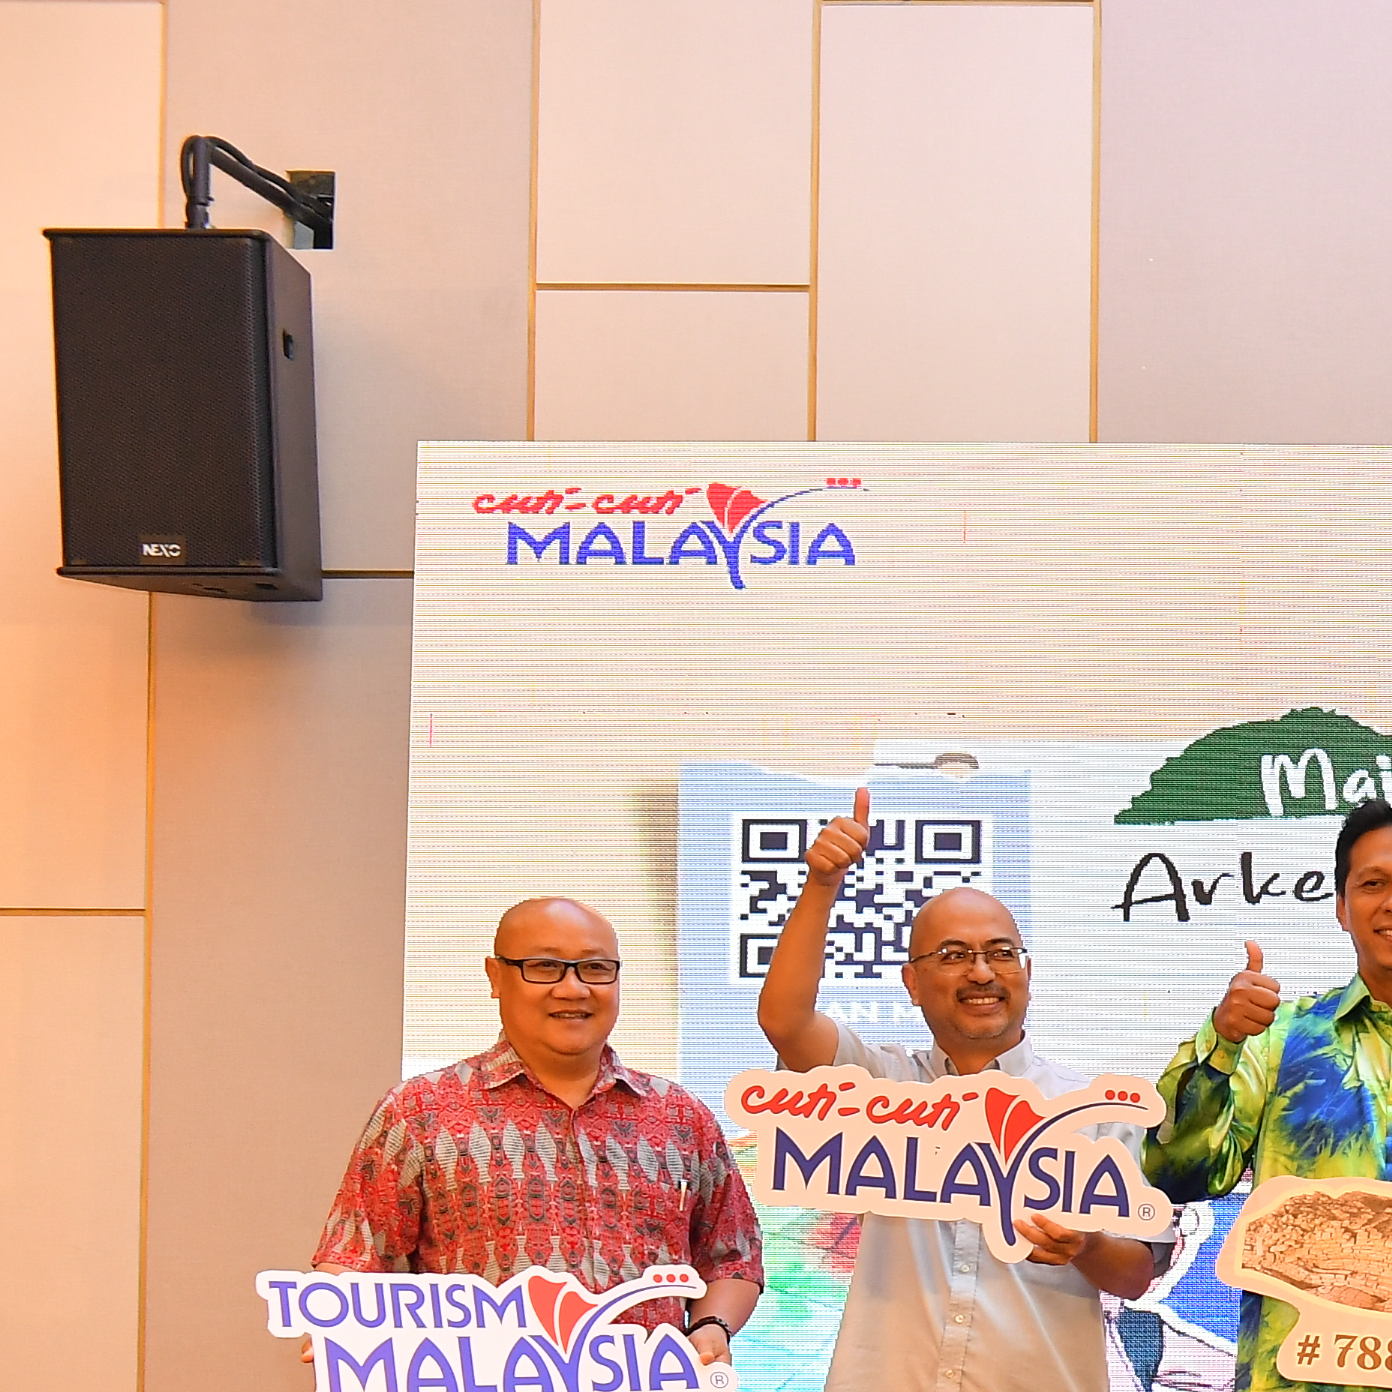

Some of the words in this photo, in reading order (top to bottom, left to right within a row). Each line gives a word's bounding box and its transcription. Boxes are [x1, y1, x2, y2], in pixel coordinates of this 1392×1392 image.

[142, 543, 182, 558] NEXO
[505, 520, 856, 589] MALAYSIA
[740, 1081, 980, 1131] cuti-cuti
[772, 1126, 1130, 1246] MALAYSIA
[269, 1281, 529, 1329] TOURISM
[1297, 1334, 1321, 1366] #
